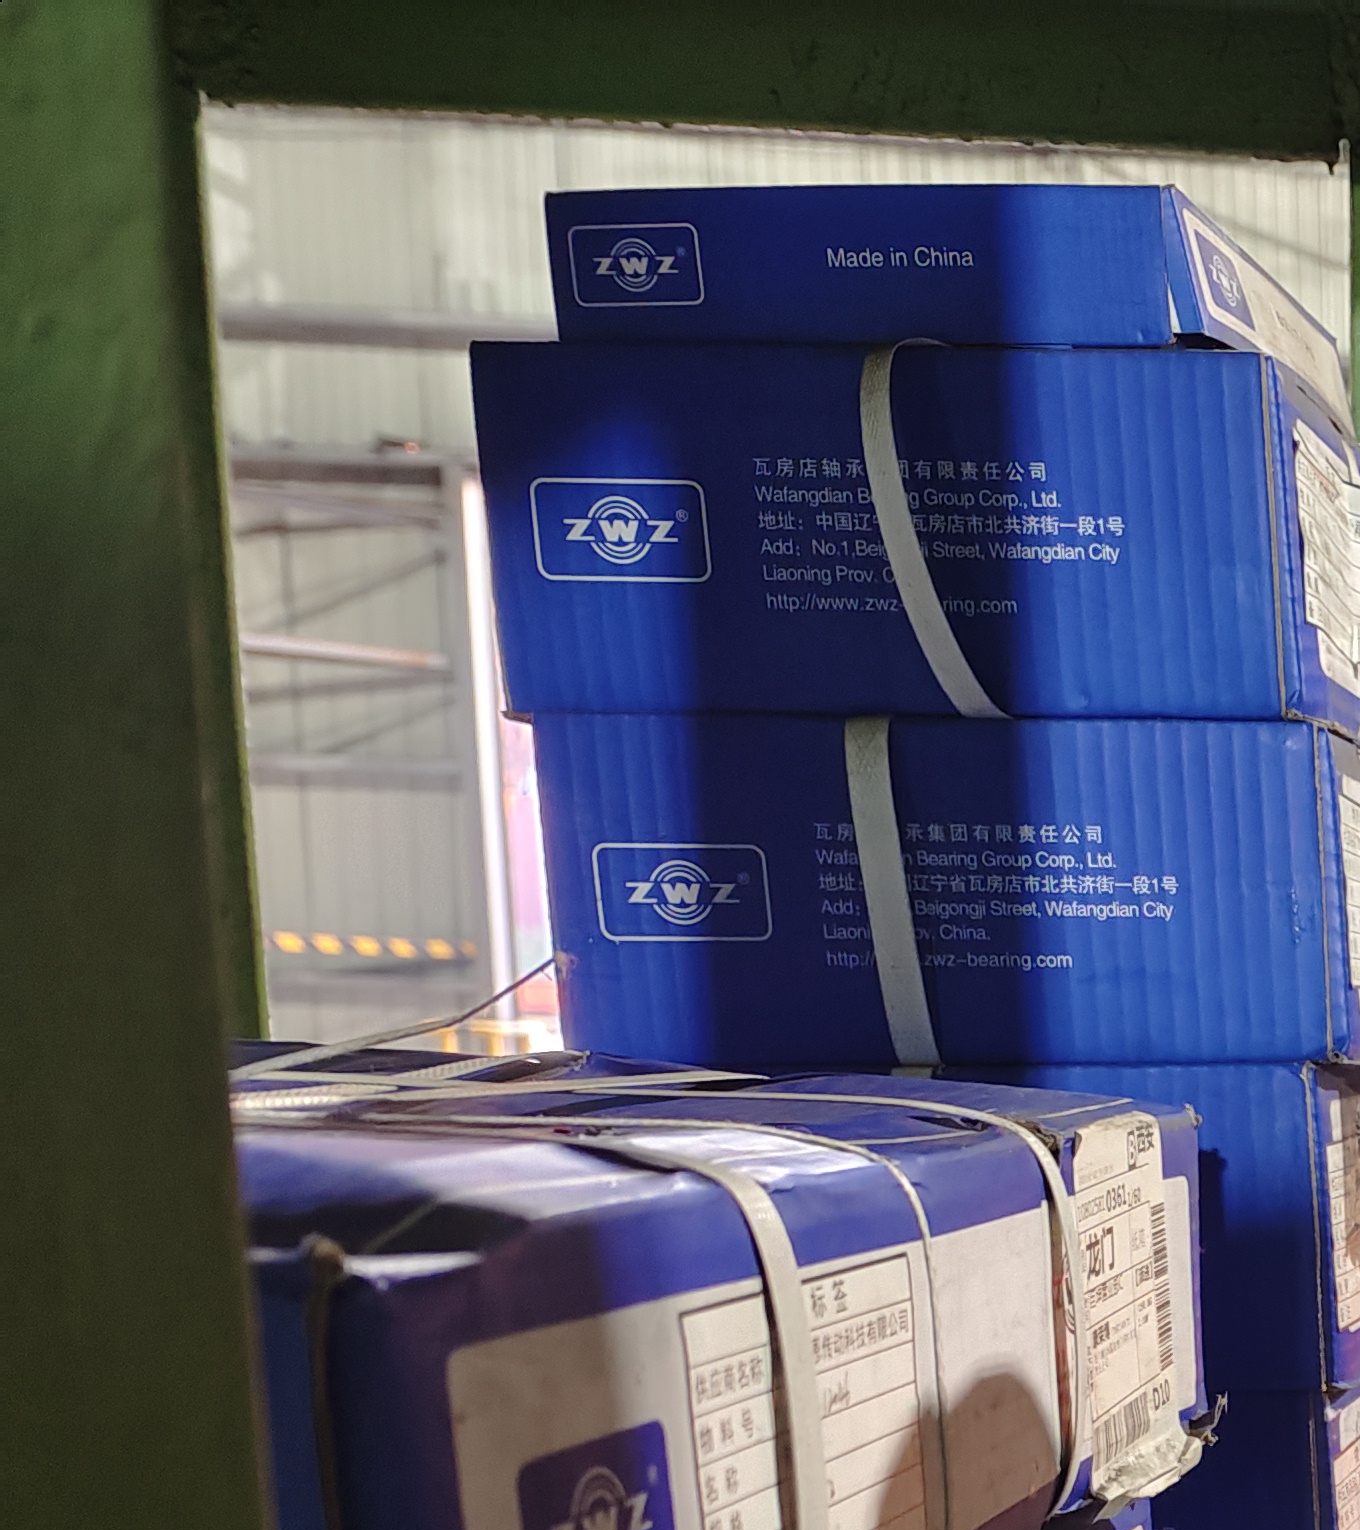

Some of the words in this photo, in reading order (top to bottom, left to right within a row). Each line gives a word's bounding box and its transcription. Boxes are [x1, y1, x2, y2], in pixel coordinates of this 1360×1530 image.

[826, 247, 884, 268] Made
[889, 246, 908, 267] in
[914, 246, 974, 267] China
[752, 457, 1048, 482] 瓦房店轴承团有限责任公司
[754, 486, 853, 507] Wafangdian
[924, 488, 975, 508] Group
[1031, 490, 1062, 508] Ltd.
[815, 512, 1125, 537] 中国辽瓦房店市北共济街一段1号
[932, 542, 985, 561] Street,
[988, 543, 1085, 563] Wafangdian
[1088, 544, 1121, 565] City
[762, 565, 832, 586] Liaoning
[836, 566, 879, 583] Prov.
[765, 592, 1018, 616] http://www.zwz-ring.com
[813, 823, 1103, 845] 瓦房承集团有限责任公司
[916, 851, 978, 871] Bearing
[981, 852, 1032, 871] Group
[1034, 852, 1084, 872] Corp.,
[1086, 852, 1118, 869] Ltd.
[907, 874, 1180, 896] 辽宁省瓦房店市北共济街一段1号
[990, 902, 1042, 920] Street,
[1045, 902, 1140, 921] Wafangdian
[1143, 902, 1174, 922] City
[823, 924, 871, 941] Liaoni
[826, 951, 1073, 970] http://.zwz-bearing.com
[1086, 1225, 1115, 1281] 龙门
[1152, 1378, 1170, 1412] D10
